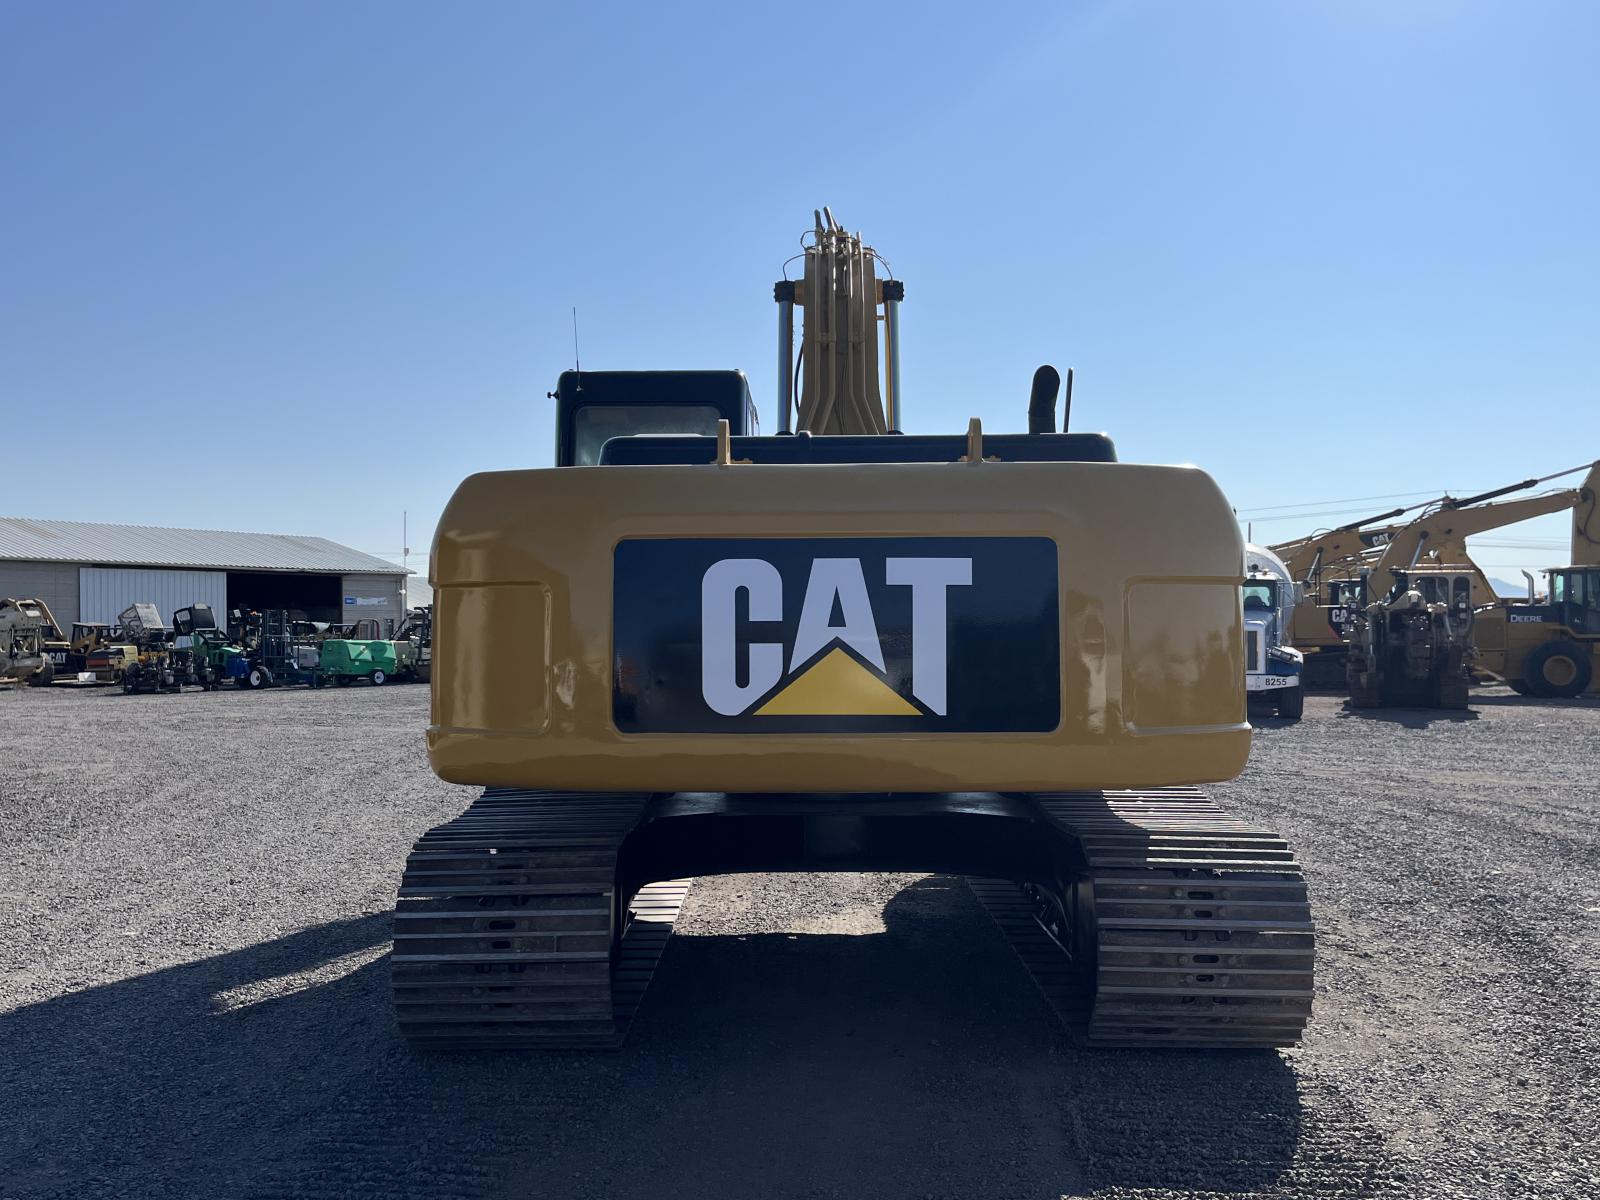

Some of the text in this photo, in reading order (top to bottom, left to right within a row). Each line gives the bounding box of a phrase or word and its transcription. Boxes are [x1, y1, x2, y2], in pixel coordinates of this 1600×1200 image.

[1372, 533, 1390, 546] CAT
[1332, 609, 1348, 622] CA
[1510, 614, 1543, 623] DEERE
[702, 557, 972, 716] CAT
[1265, 678, 1287, 686] 8255
